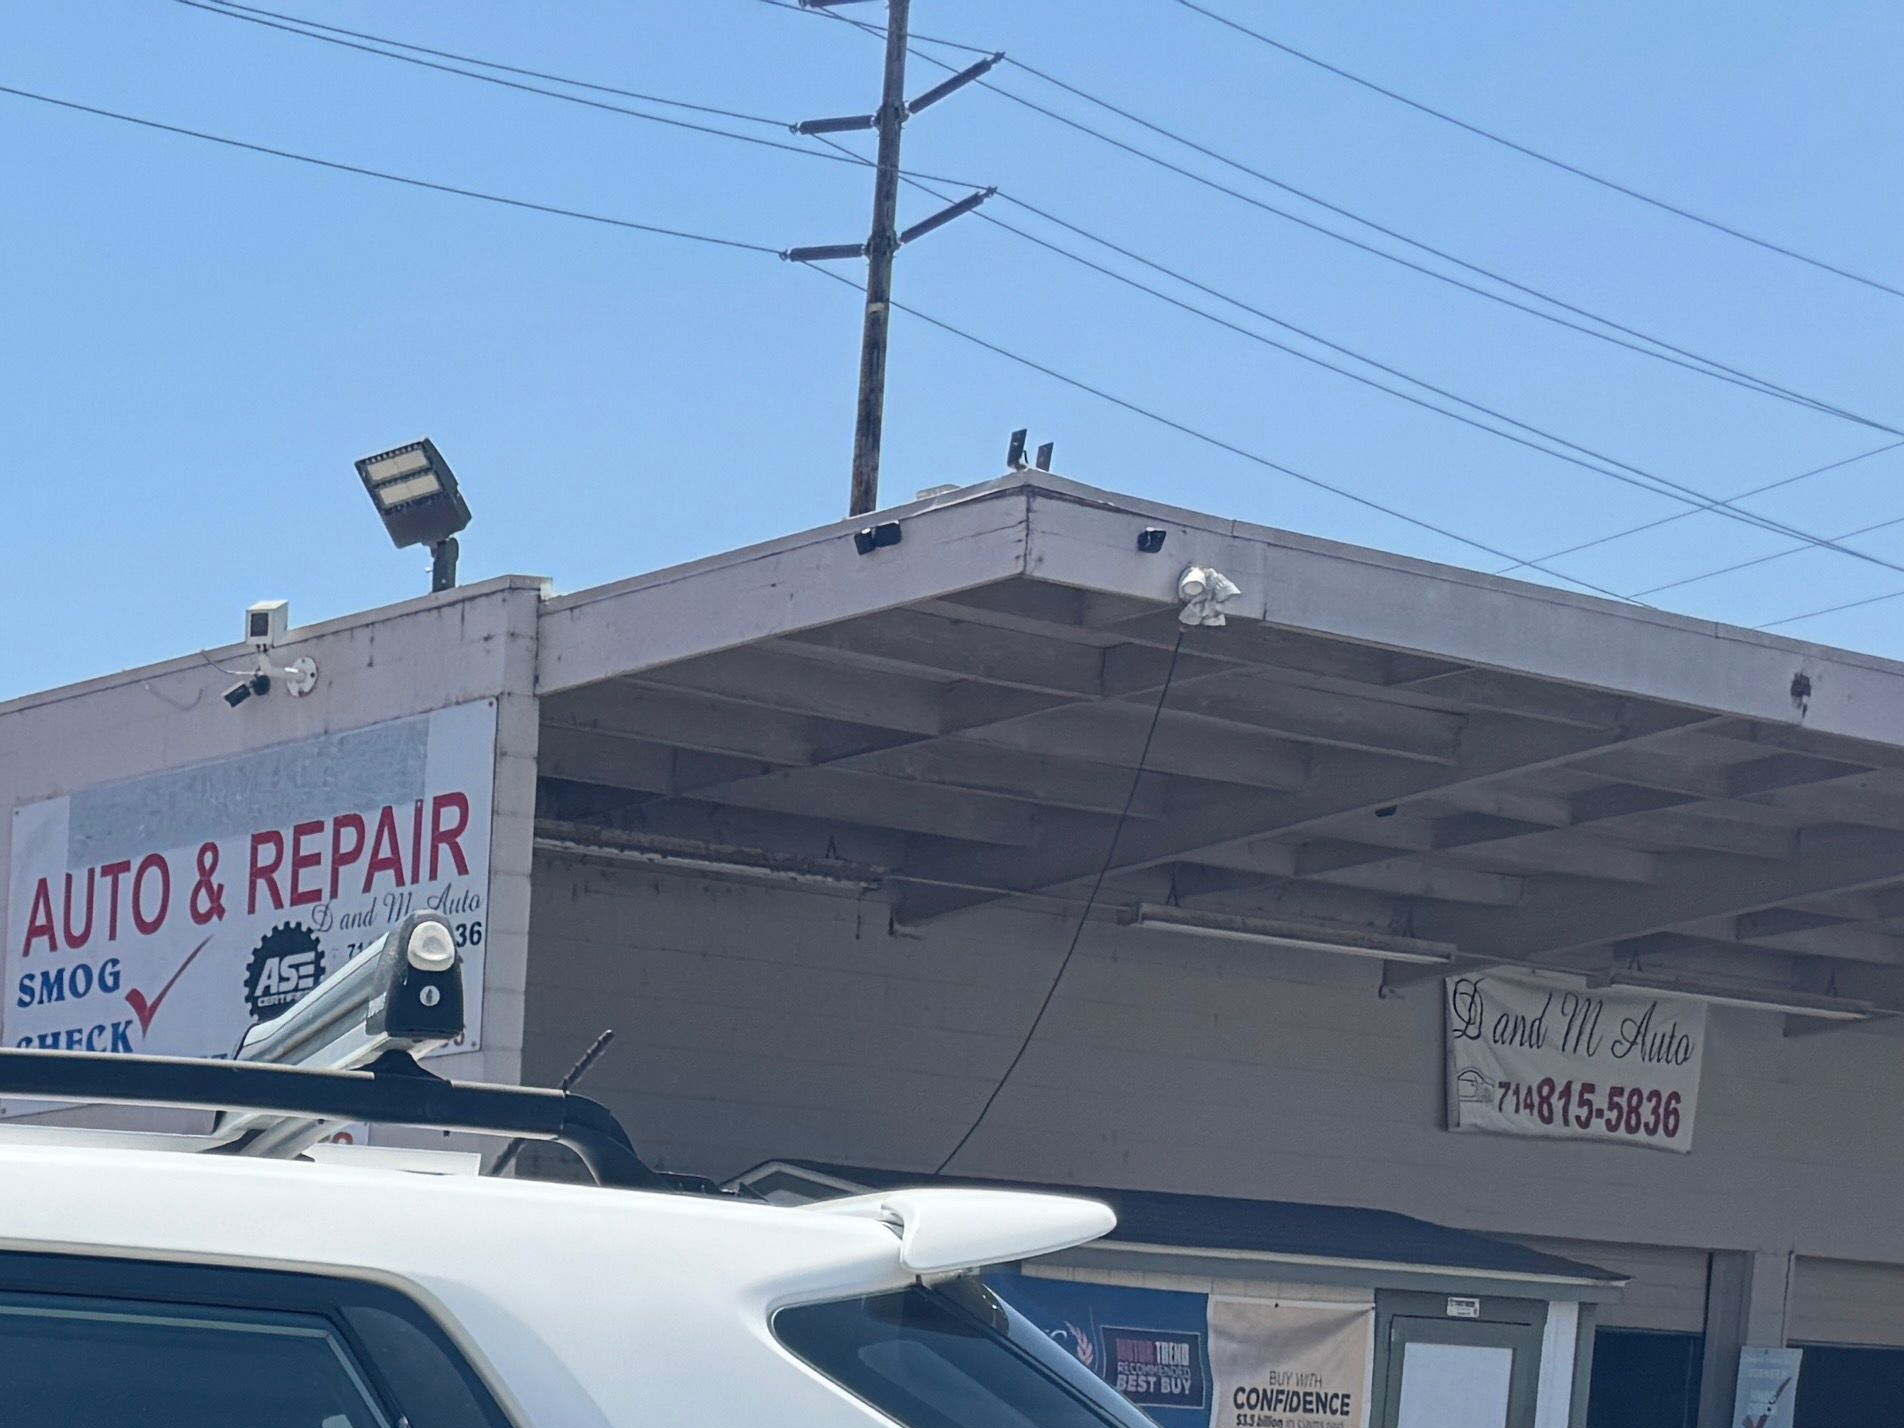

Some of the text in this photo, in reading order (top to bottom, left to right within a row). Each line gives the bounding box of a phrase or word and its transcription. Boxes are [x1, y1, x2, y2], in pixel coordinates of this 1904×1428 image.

[22, 791, 470, 957] AUTO & REPAIR
[311, 904, 334, 933] D
[339, 902, 376, 931] and
[17, 957, 122, 1008] SMOG
[254, 952, 316, 997] ASE
[1453, 978, 1692, 1066] D and M Auto
[1116, 1374, 1191, 1395] BEST BUY
[1117, 1361, 1191, 1380] RECOMMENDED
[1269, 1371, 1322, 1389] BUY WITH
[1233, 1386, 1351, 1416] CONFIDENCE
